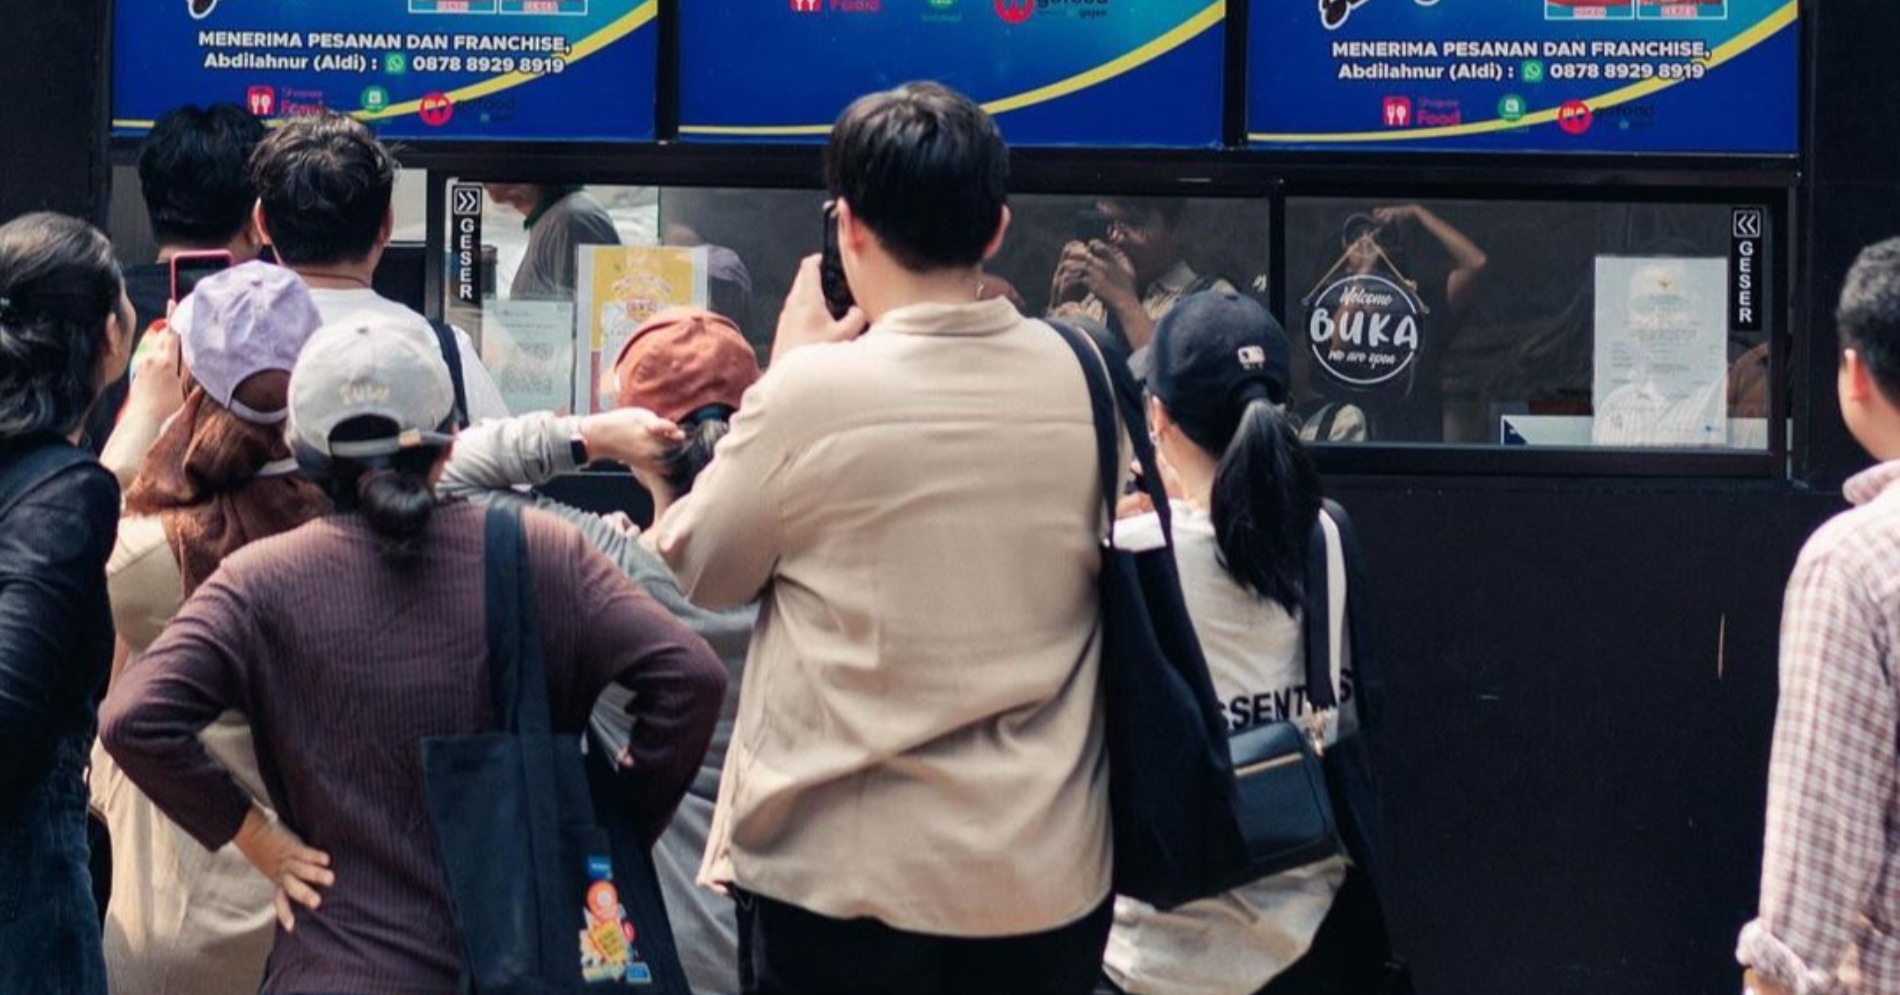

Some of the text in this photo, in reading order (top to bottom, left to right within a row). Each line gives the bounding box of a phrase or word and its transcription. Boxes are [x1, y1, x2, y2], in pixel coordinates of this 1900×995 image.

[198, 31, 571, 54] MENERIMA PESANAN DAN FRANCHISE,
[1332, 42, 1711, 60] MENERIMA PESANAN DAN FRANCHISE,
[204, 52, 308, 69] Abdilahnur
[313, 54, 366, 72] (Aldi)
[412, 56, 461, 71] 0878
[466, 57, 514, 71] 8929
[519, 57, 565, 73] 8919
[1338, 62, 1444, 79] Abdilahnur
[1449, 63, 1502, 81] (Aldi)
[1550, 63, 1599, 78] 0878
[1604, 63, 1653, 78] 8929
[1658, 63, 1705, 78] 8919
[459, 217, 474, 300] GESER
[1738, 241, 1753, 323] GESER
[1310, 308, 1418, 350] BUKA
